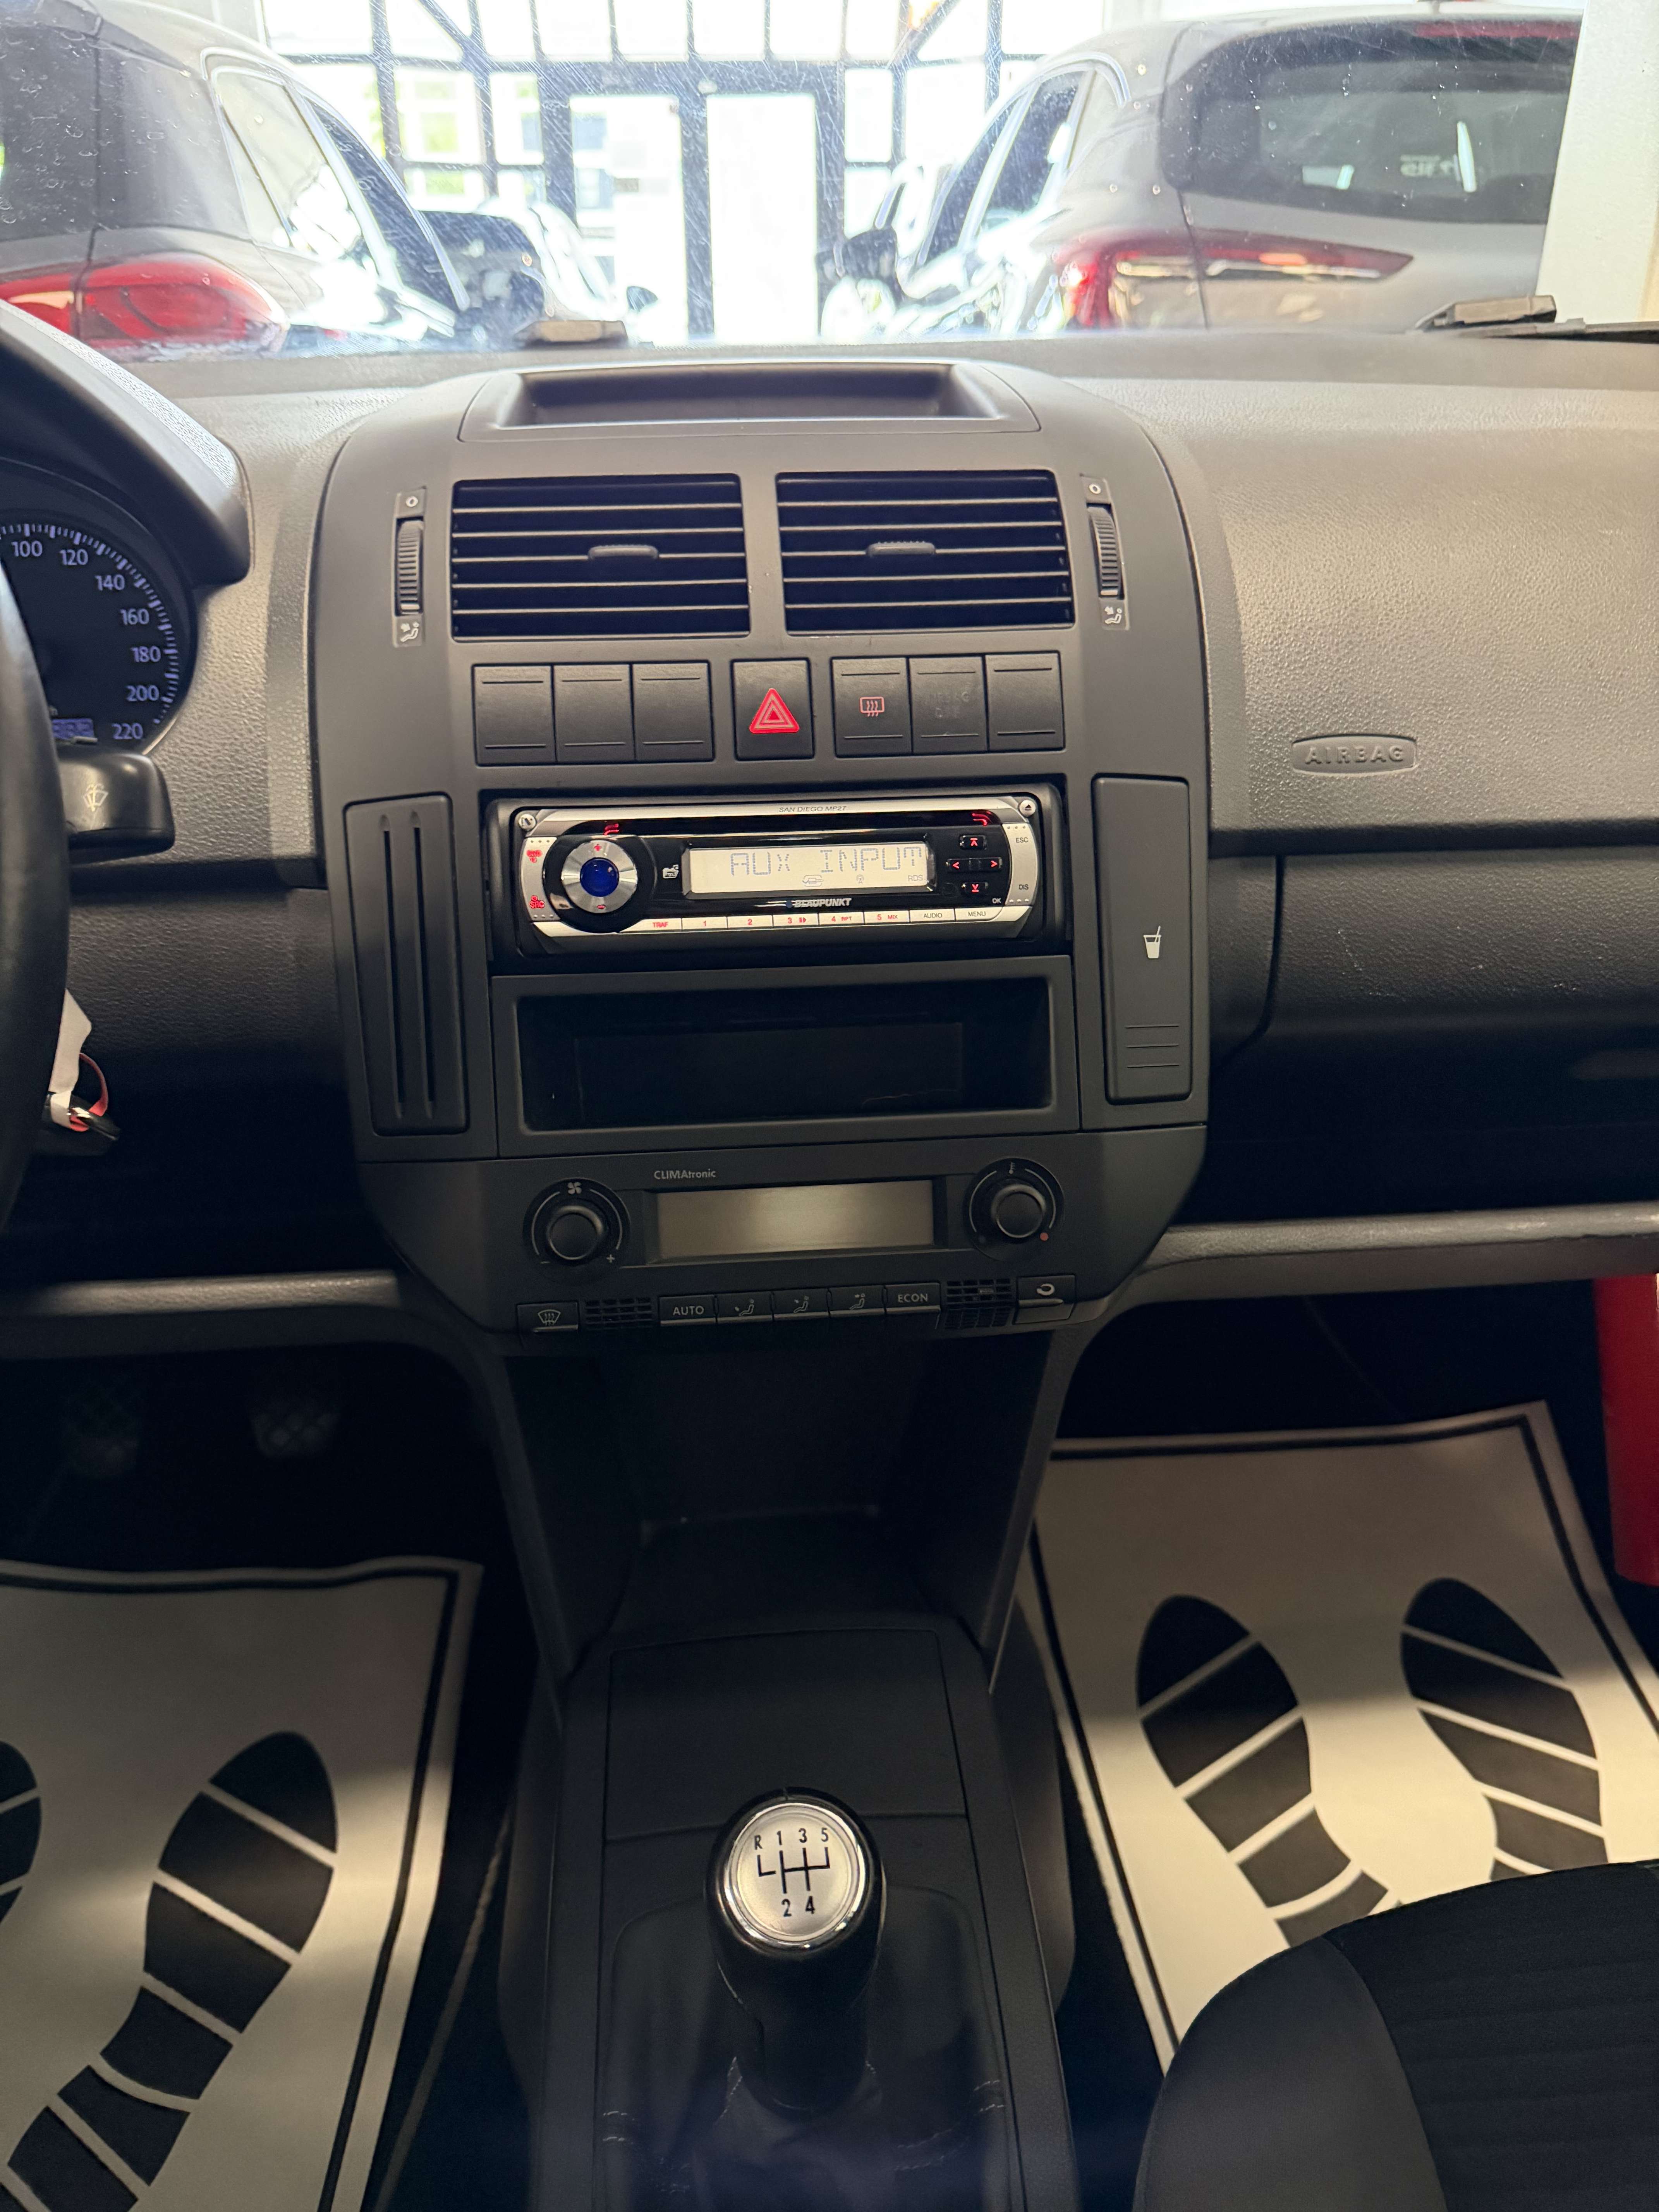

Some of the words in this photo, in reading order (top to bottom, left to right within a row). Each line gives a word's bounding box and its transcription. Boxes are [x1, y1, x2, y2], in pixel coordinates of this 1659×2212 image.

[11, 541, 43, 557] 100
[60, 549, 88, 566] 120
[95, 574, 125, 591] 140
[120, 608, 150, 625] 160
[131, 646, 161, 663] 180
[127, 685, 159, 702] 200
[112, 723, 143, 740] 220
[1304, 744, 1404, 764] AIRBAG
[730, 852, 790, 876] AUX
[820, 846, 922, 872] INPUT
[794, 898, 852, 908] BLAUPUNKT
[654, 1168, 716, 1179] CLIMAtronic
[897, 1293, 928, 1303] ECON
[672, 1305, 704, 1316] AUTO
[754, 1835, 763, 1850] R
[776, 1830, 782, 1846] 1
[798, 1828, 807, 1843] 3
[821, 1827, 829, 1842] 5
[781, 1898, 792, 1917] 2
[805, 1896, 815, 1914] 4
